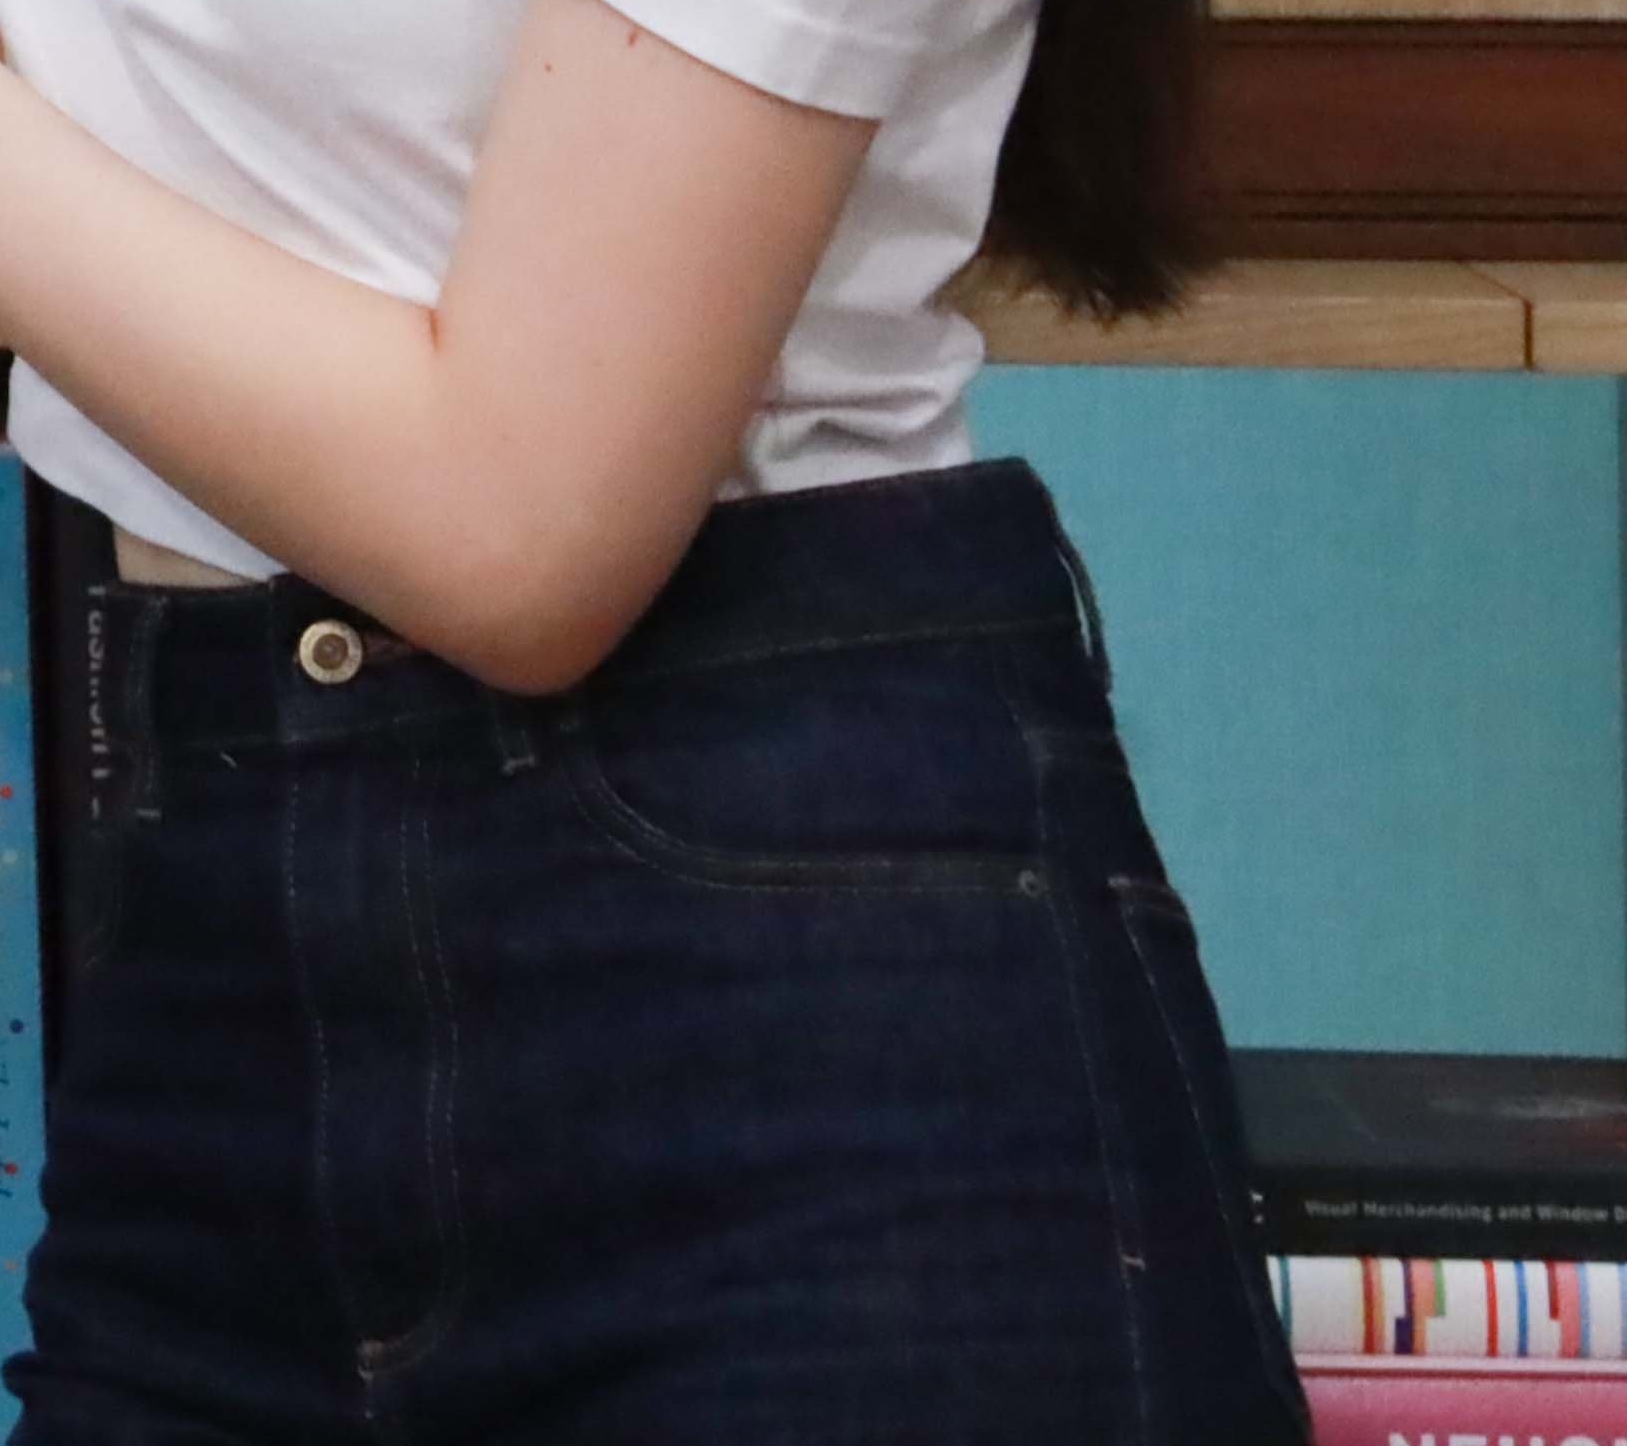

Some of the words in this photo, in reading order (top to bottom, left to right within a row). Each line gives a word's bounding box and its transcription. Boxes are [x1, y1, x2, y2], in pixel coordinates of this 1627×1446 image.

[1304, 1199, 1358, 1218] Visual
[1363, 1200, 1493, 1223] Merchandising
[1498, 1203, 1532, 1220] and
[1536, 1203, 1609, 1222] Window
